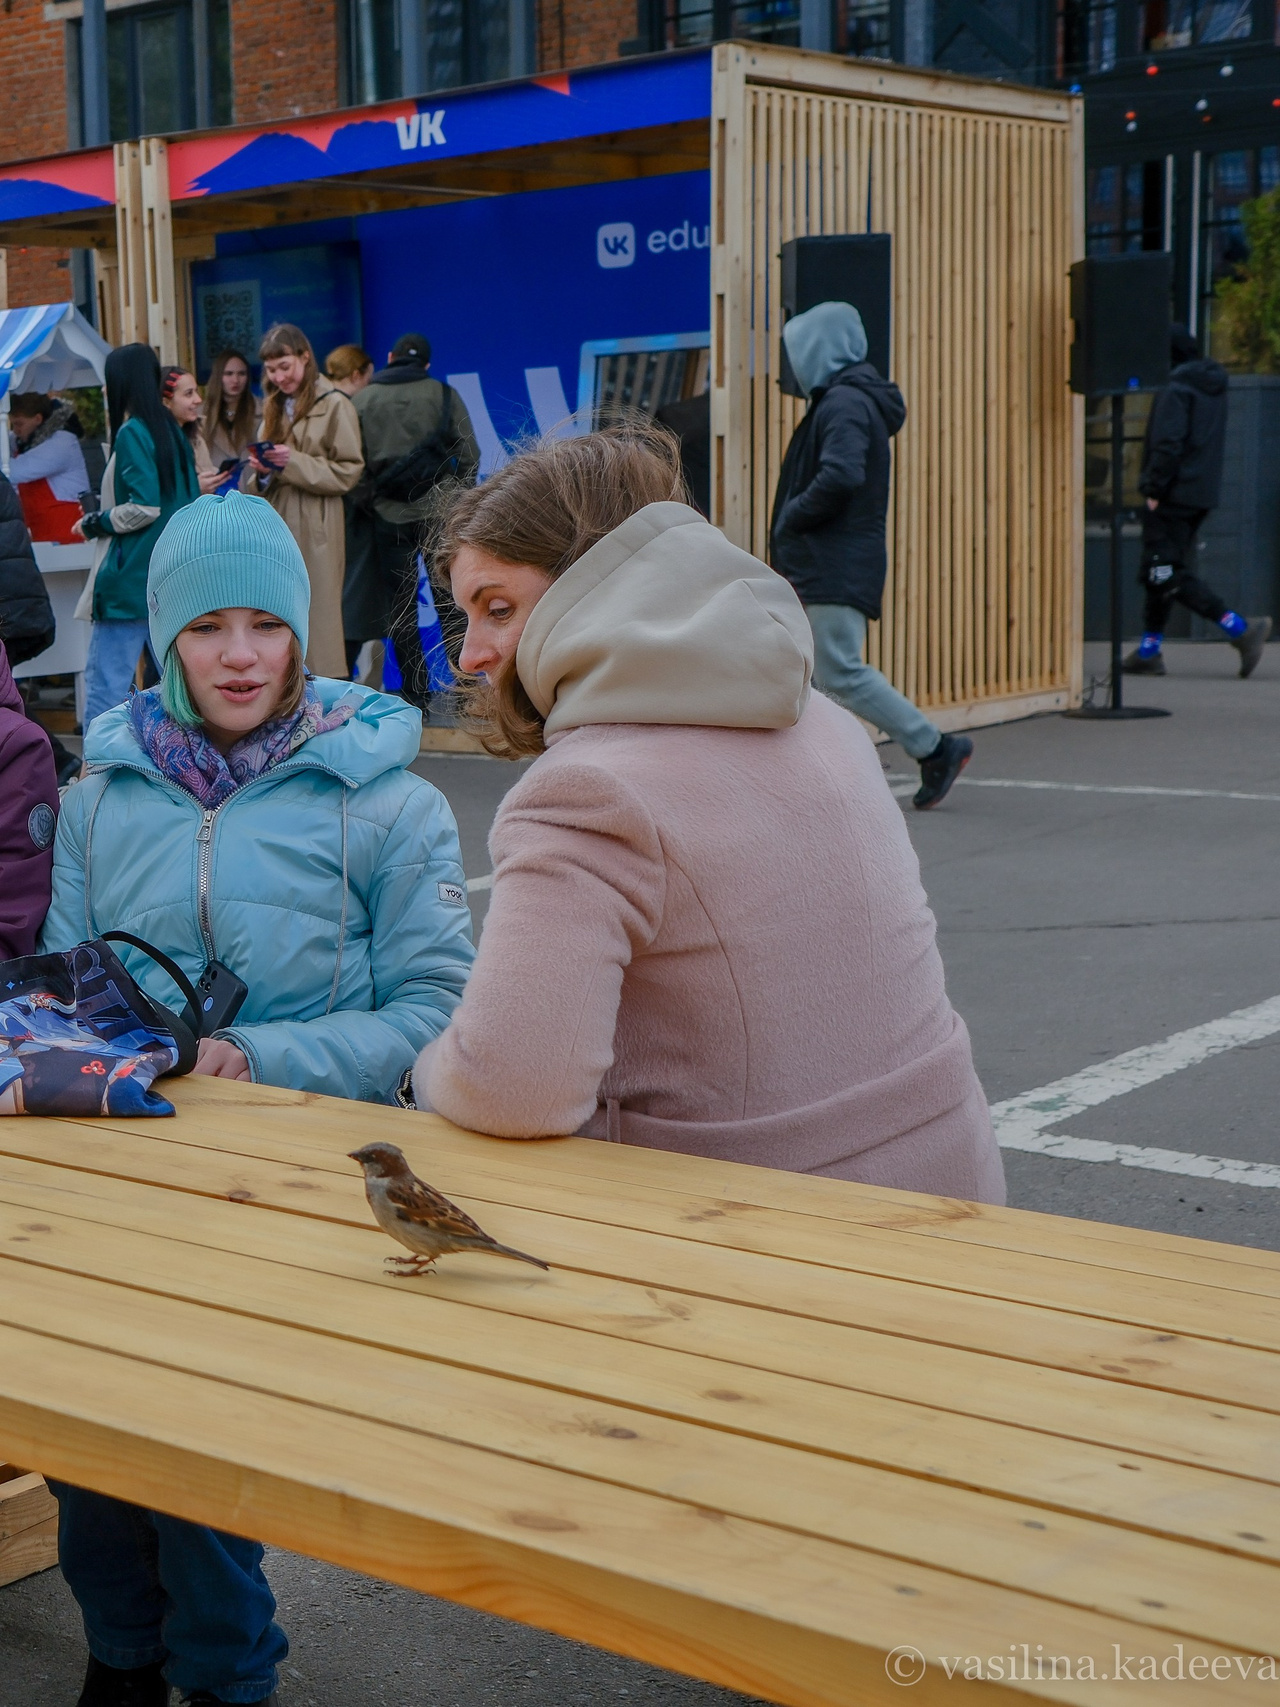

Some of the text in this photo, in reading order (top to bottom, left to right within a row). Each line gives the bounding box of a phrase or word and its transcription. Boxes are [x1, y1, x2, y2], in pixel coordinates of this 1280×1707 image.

[396, 110, 446, 150] VK
[603, 220, 710, 255] VK edu
